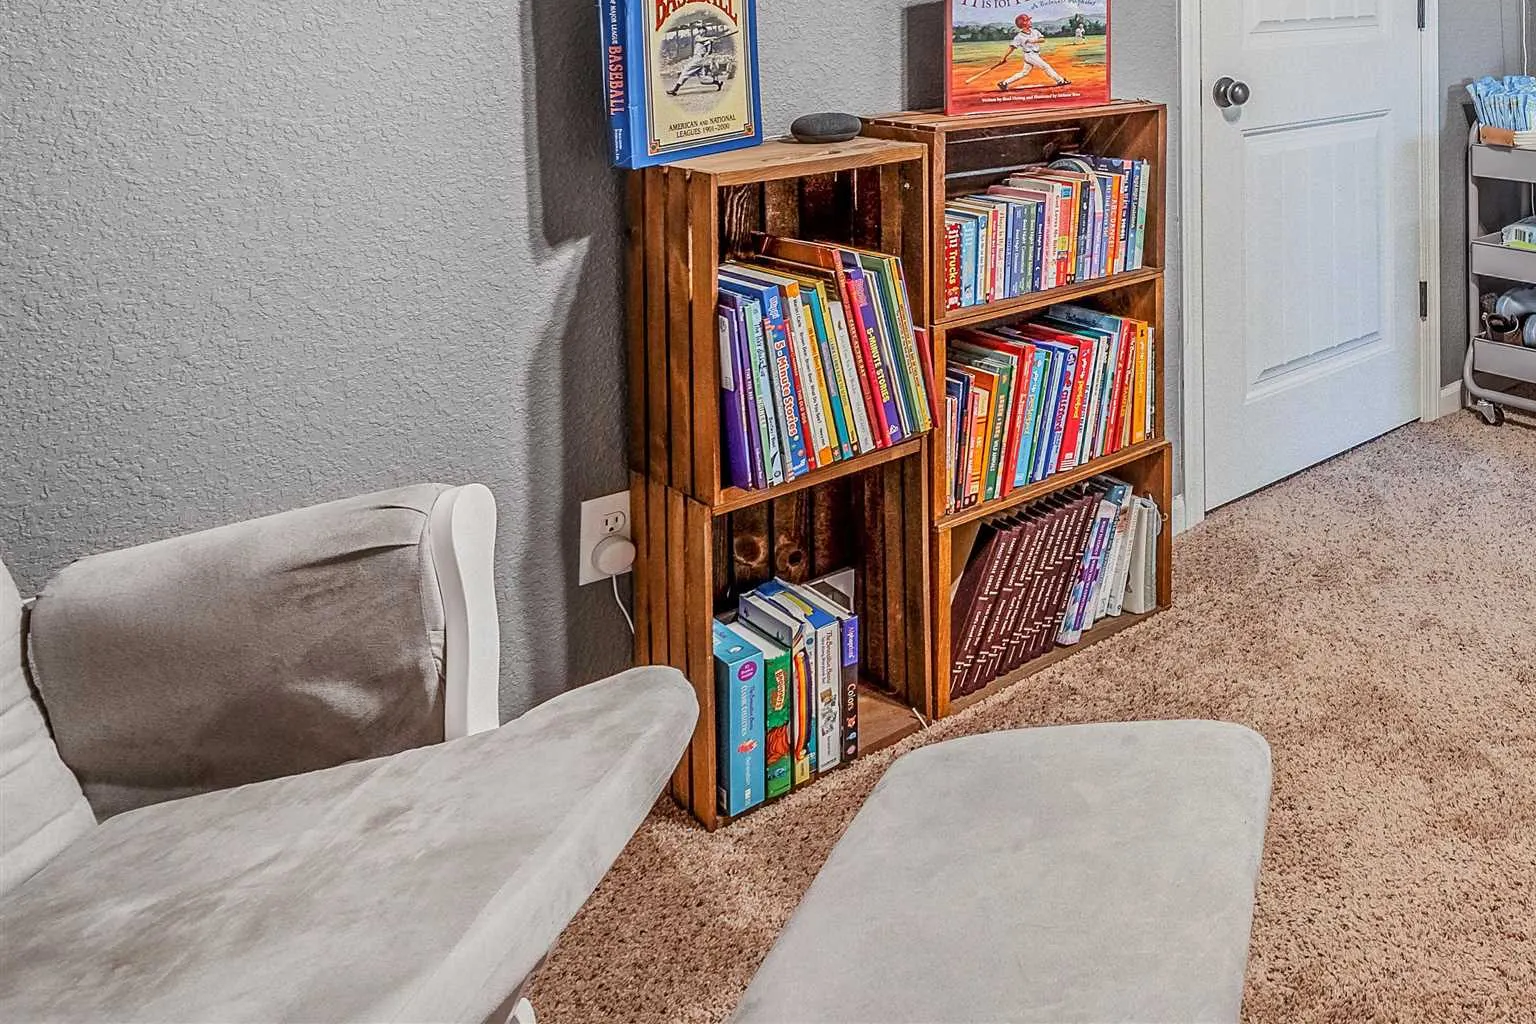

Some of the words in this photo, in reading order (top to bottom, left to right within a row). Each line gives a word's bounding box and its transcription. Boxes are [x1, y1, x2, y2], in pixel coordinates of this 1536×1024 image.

[609, 5, 617, 22] MAJOR
[610, 24, 618, 44] LEAGUE
[607, 45, 625, 115] BASEBALL
[669, 121, 698, 131] AMERICAN
[709, 114, 736, 124] NATIONAL
[676, 128, 701, 138] LEAGUES
[948, 249, 957, 284] Trucks
[798, 331, 806, 346] Brown
[803, 358, 812, 371] Brown
[865, 327, 882, 368] 5-MINUTE
[874, 368, 890, 403] STORIES
[811, 395, 818, 403] Do
[812, 403, 820, 412] You
[1054, 389, 1068, 433] Clifford
[782, 396, 799, 436] Stories
[814, 412, 822, 424] See?
[989, 452, 997, 471] ANIMALS
[1074, 521, 1082, 535] BIBLE
[1085, 518, 1093, 532] BIBLE
[1055, 531, 1063, 545] BIBLE
[1064, 526, 1072, 540] BIBLE
[1034, 540, 1042, 554] BIBLE
[1045, 535, 1054, 549] BIBLE
[1014, 551, 1023, 565] BIBLE
[1026, 547, 1034, 561] BIBLE
[990, 560, 999, 574] BIBLE
[1001, 555, 1009, 569] BIBLE
[846, 683, 855, 710] Colors
